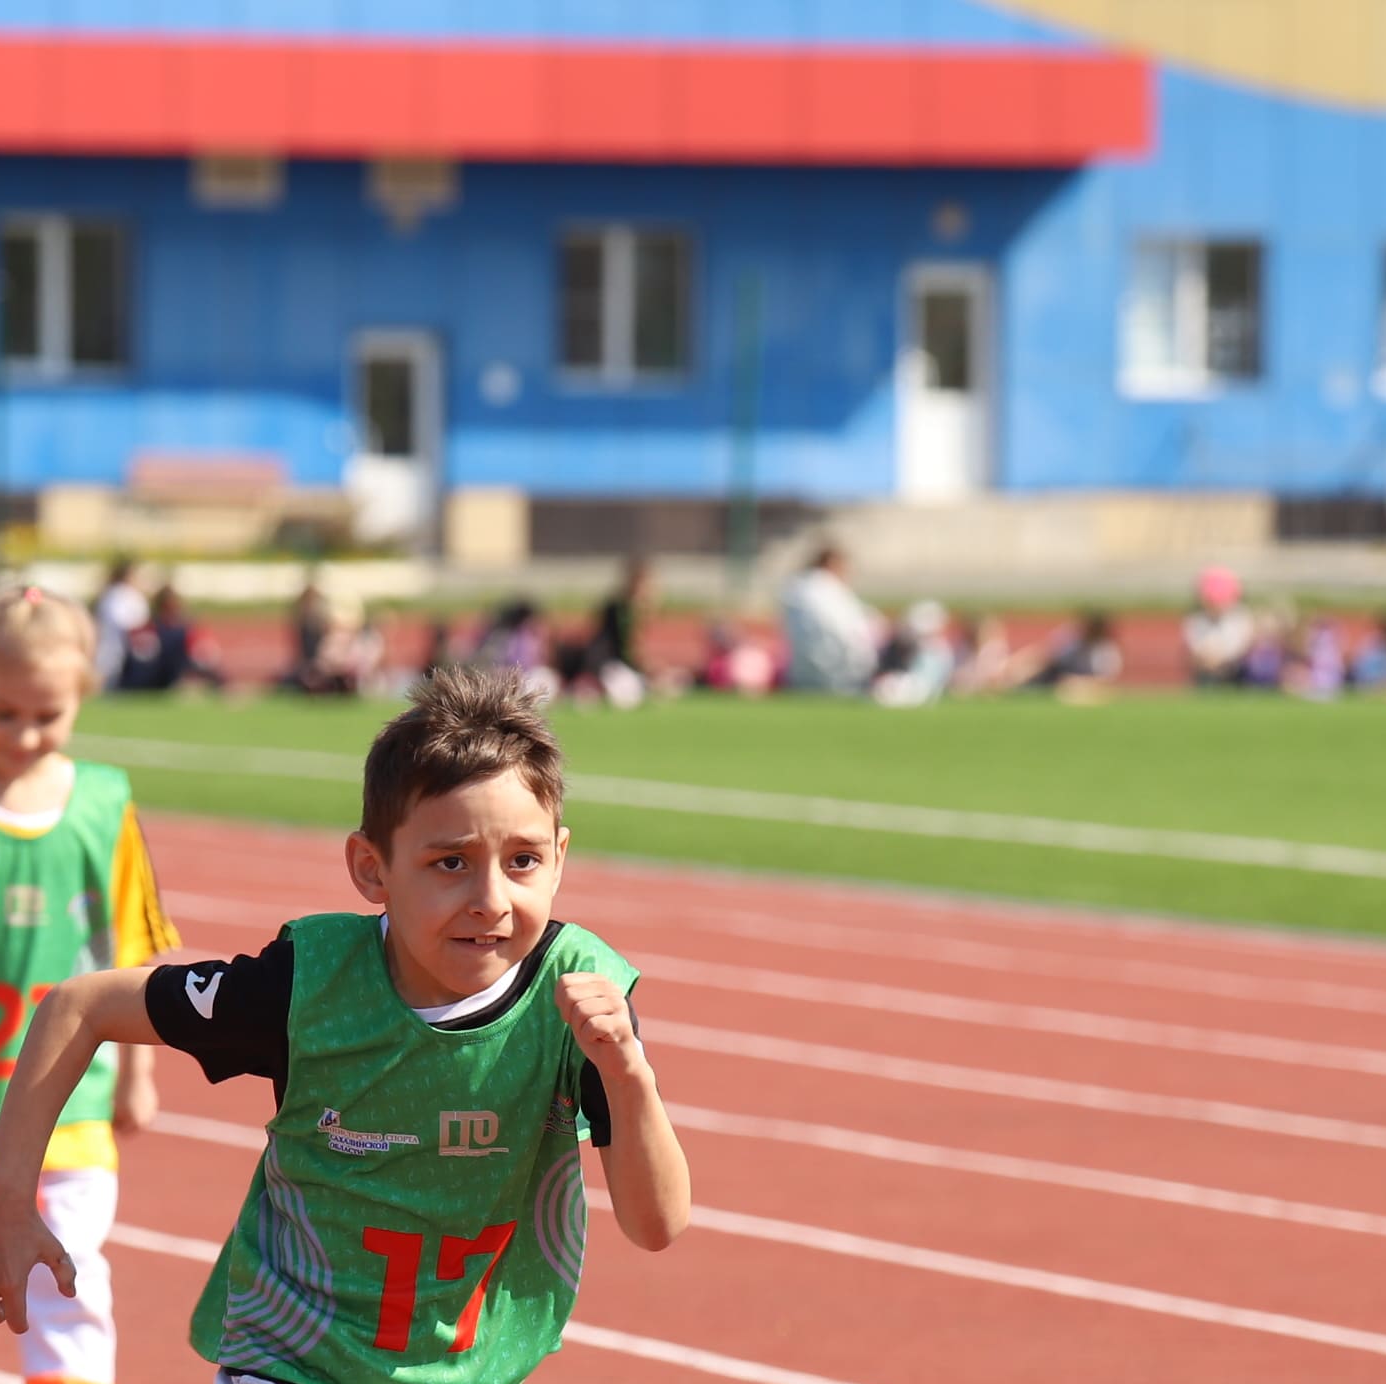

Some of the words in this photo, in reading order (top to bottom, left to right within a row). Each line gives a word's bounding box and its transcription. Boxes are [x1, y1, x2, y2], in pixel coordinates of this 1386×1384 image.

[385, 1134, 418, 1143] СПОРТА
[439, 1110, 499, 1148] ГТО
[363, 1219, 518, 1353] 17
